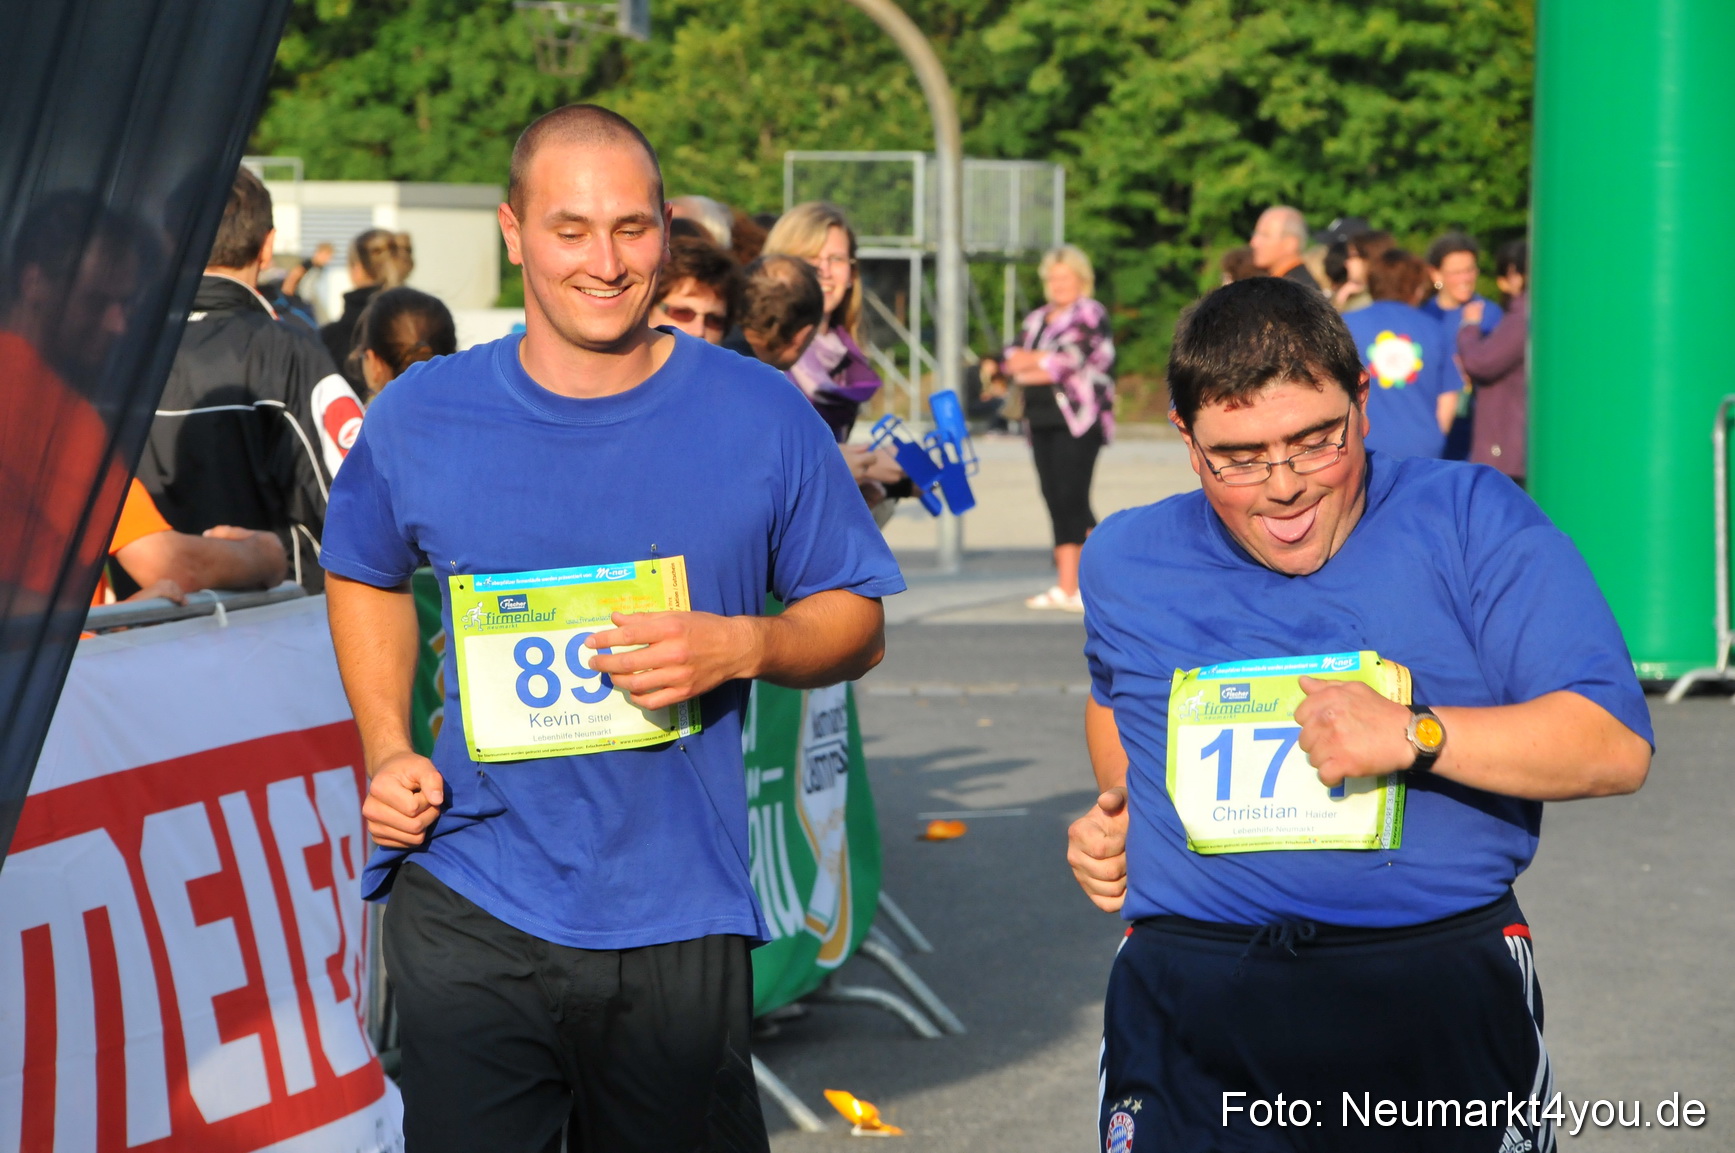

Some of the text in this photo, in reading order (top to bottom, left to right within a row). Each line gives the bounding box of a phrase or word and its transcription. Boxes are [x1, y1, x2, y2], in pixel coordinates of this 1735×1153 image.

[485, 607, 557, 625] firmenlauf
[513, 630, 615, 709] 89
[1203, 697, 1279, 716] firmenlauf
[529, 710, 612, 729] Kevin Sittel
[532, 728, 612, 743] Lebenhilfe Neumarkt
[1200, 727, 1346, 801] 17
[1212, 804, 1338, 822] Christian Haider
[1275, 824, 1315, 834] Neumarkt
